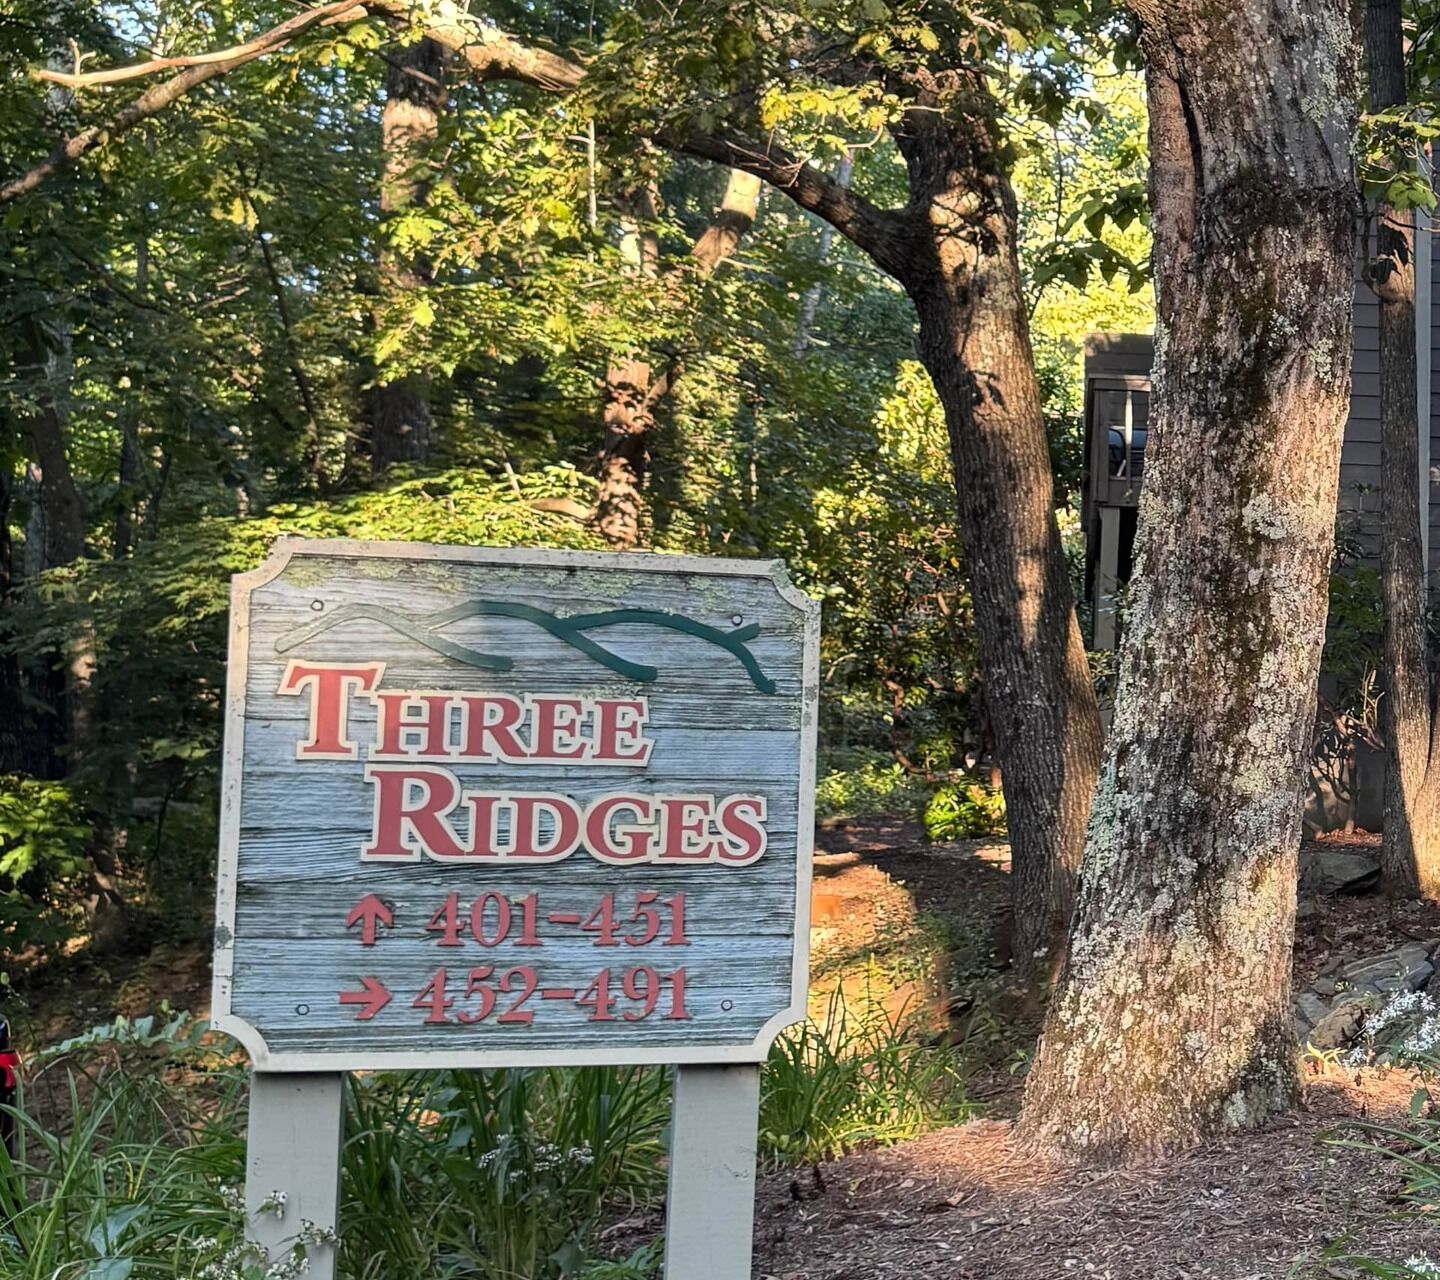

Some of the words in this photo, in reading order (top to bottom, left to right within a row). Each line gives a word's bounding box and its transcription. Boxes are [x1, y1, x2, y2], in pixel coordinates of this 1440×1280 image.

[283, 663, 652, 763] THREE
[364, 767, 767, 863] RIDGES
[425, 892, 690, 948] 401-451
[412, 966, 692, 1024] 452-491
